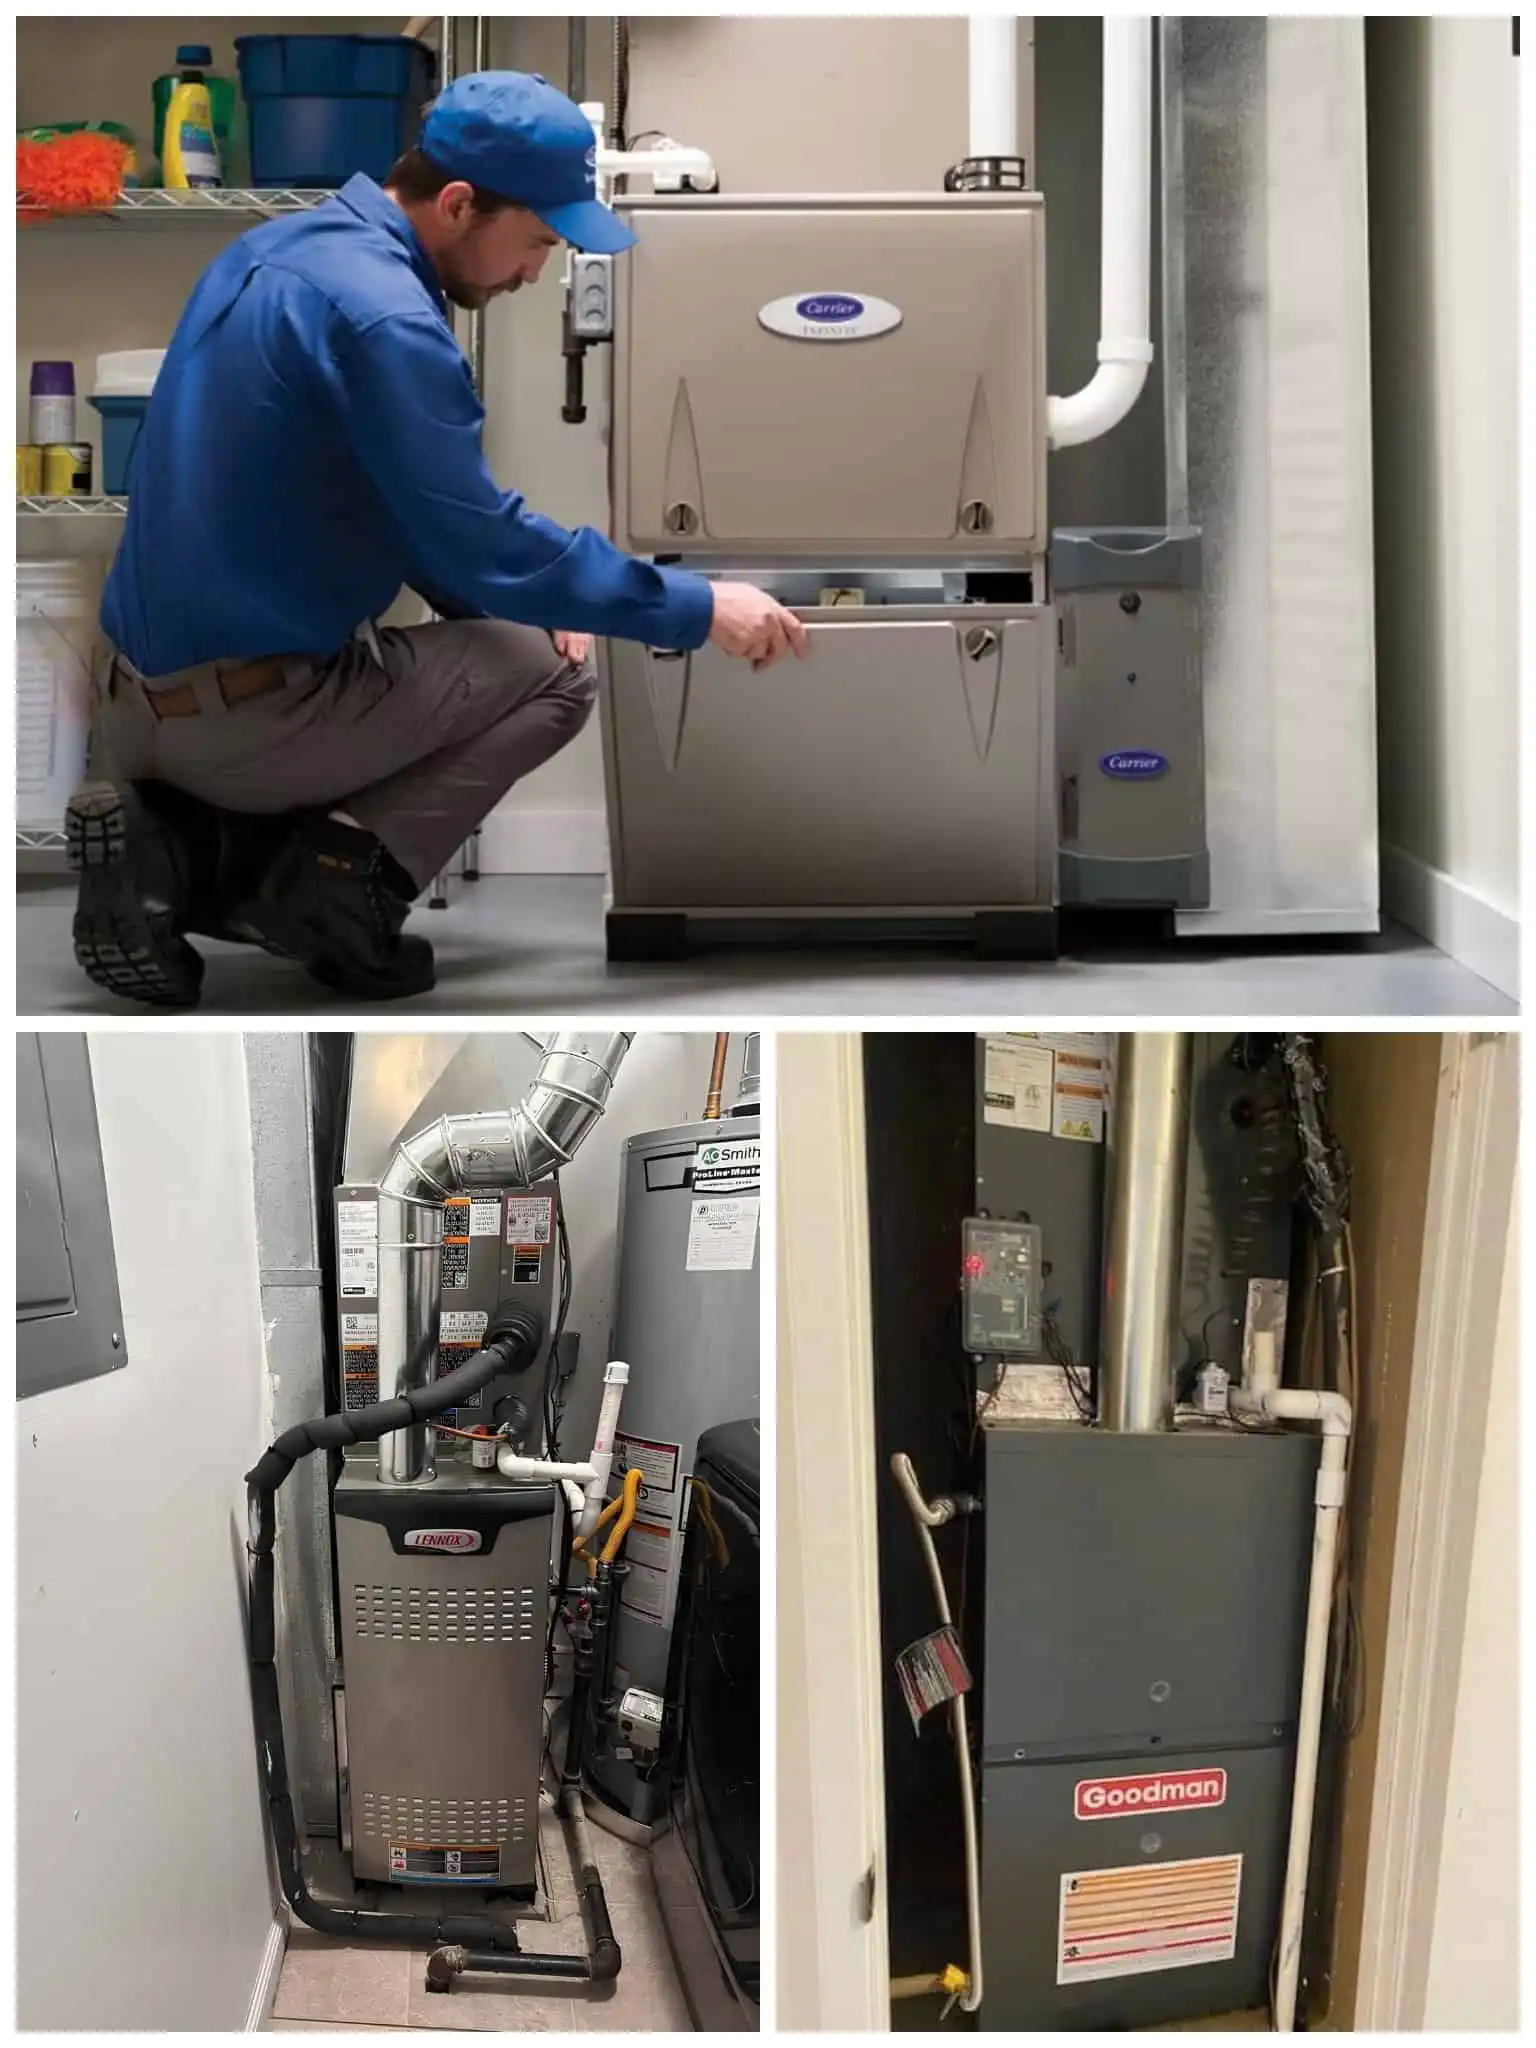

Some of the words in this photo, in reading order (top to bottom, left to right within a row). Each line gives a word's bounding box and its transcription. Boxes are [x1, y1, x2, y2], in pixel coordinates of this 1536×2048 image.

[805, 301, 857, 315] Carrier
[1109, 756, 1159, 769] Carrier
[721, 1146, 760, 1160] Smith
[414, 1535, 463, 1546] LENNOX
[1083, 1780, 1219, 1809] Goodman
